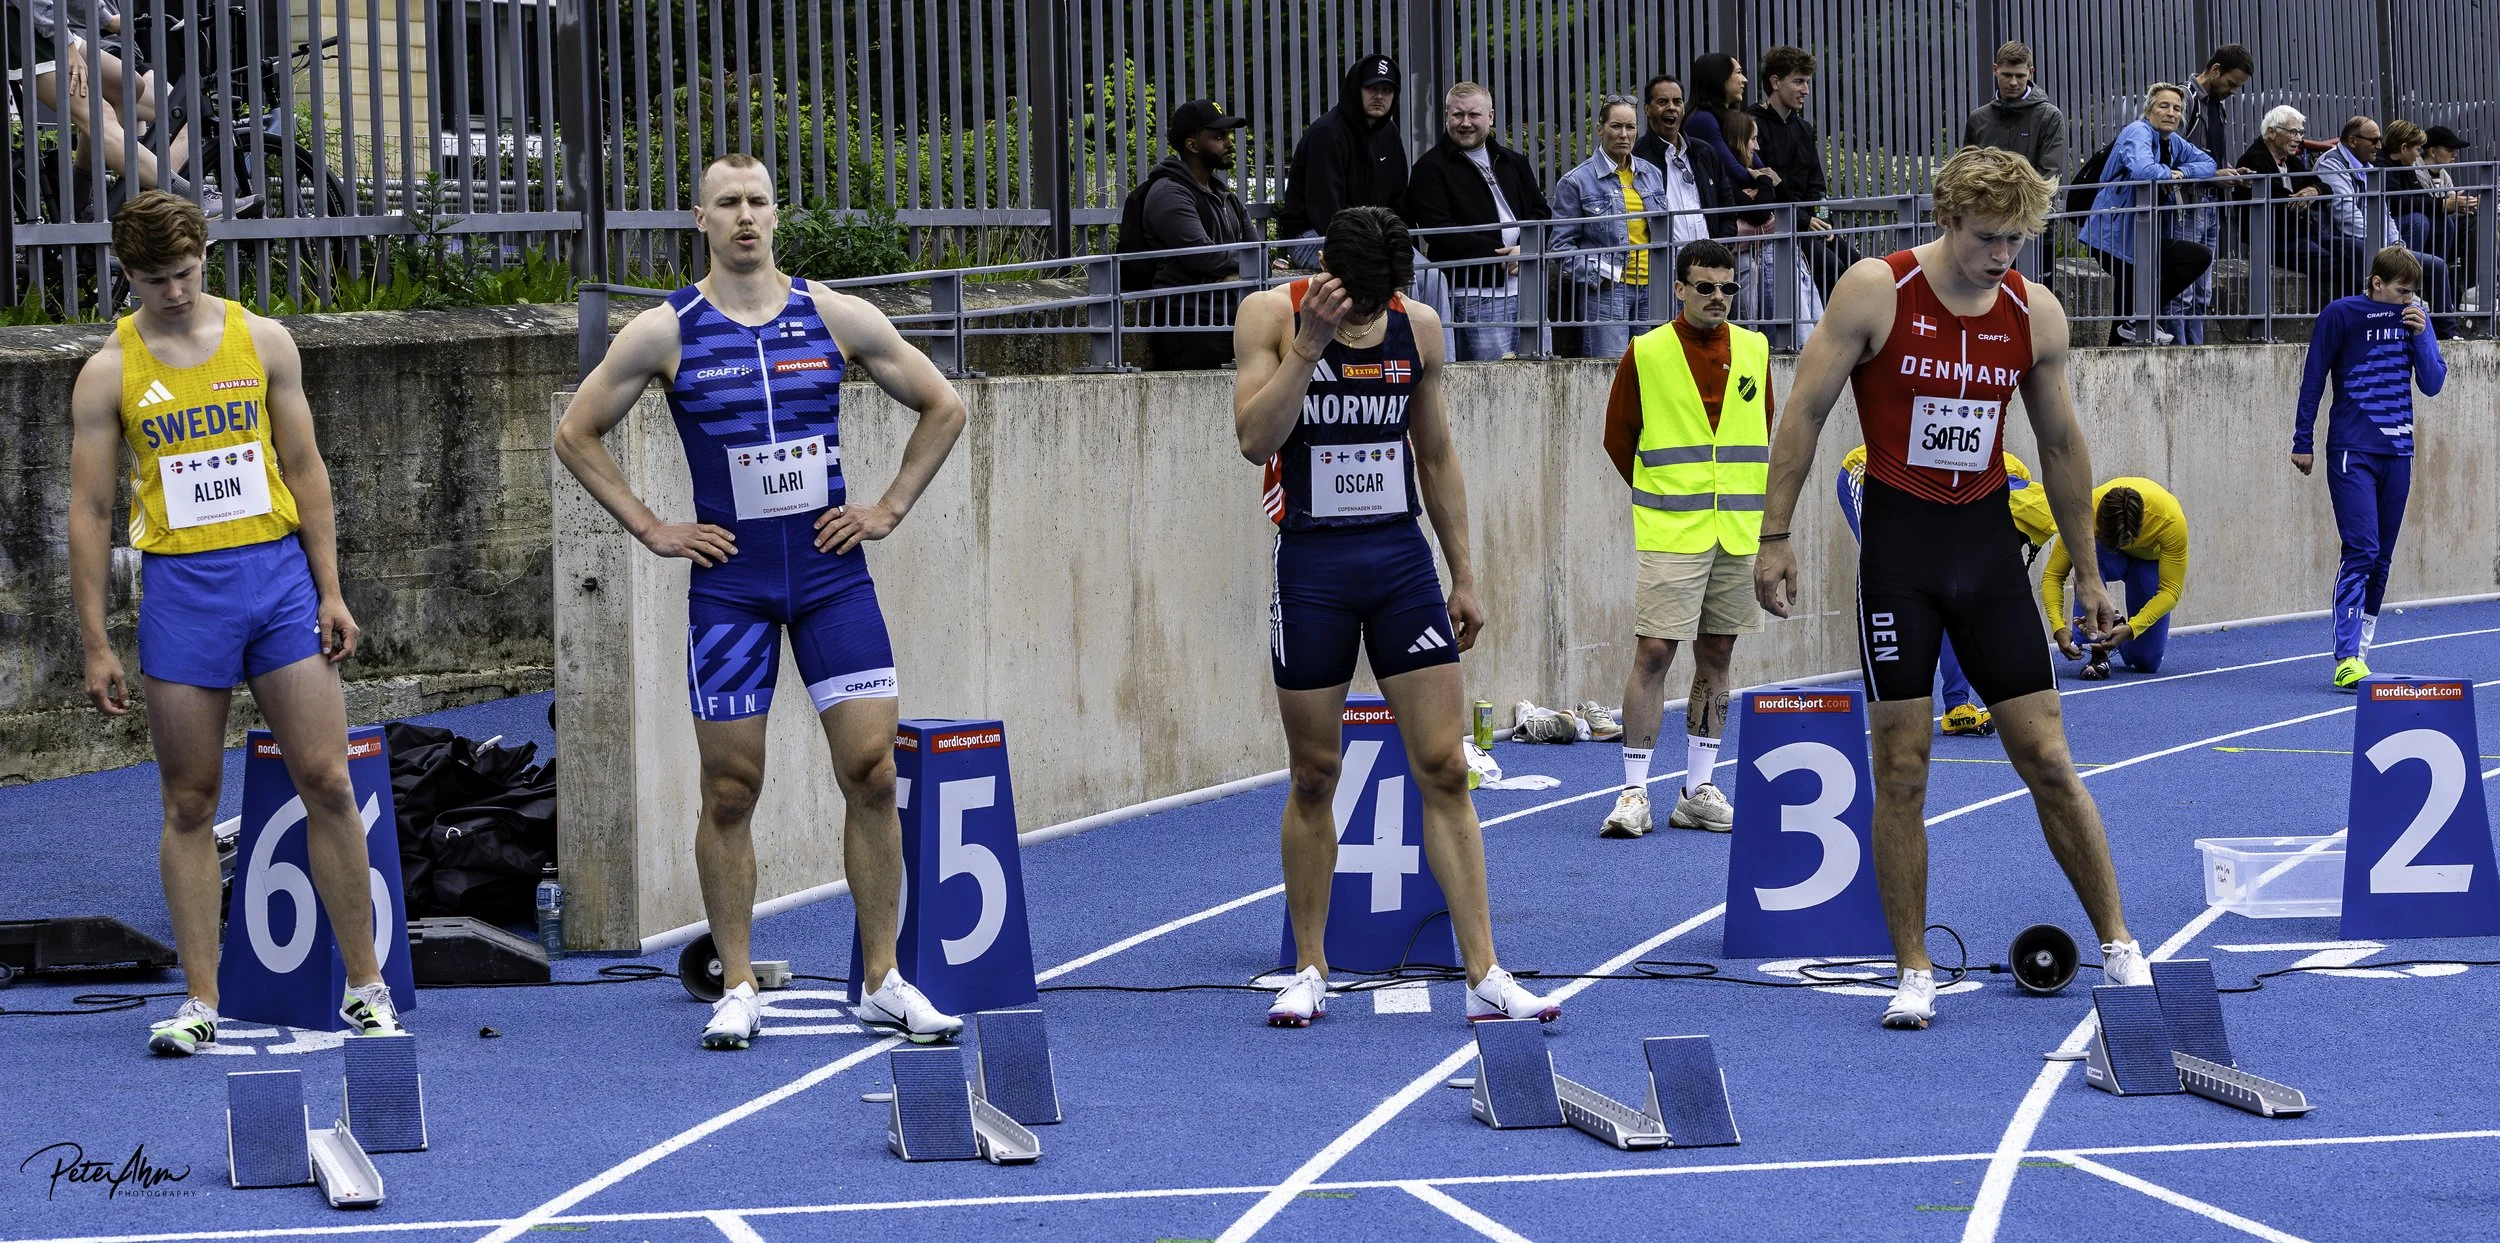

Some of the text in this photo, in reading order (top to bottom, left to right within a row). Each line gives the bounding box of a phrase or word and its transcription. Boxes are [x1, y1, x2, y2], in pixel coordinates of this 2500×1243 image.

[2366, 311, 2389, 319] CRAFT
[1978, 333, 2003, 342] CRAFT
[2366, 328, 2409, 341] FINL
[696, 367, 739, 379] CRAFT
[777, 360, 828, 371] motonet
[1900, 355, 2021, 387] DENMARK
[212, 379, 258, 390] BAUHAUS
[1303, 394, 1410, 425] NORWAY
[141, 400, 258, 449] SWEDEN
[1934, 459, 1968, 467] COPENHAGEN
[194, 476, 242, 503] ALBIN
[762, 470, 804, 495] ILARI
[1335, 473, 1384, 494] OSCAR
[196, 511, 232, 522] COPENHAGEN
[763, 505, 797, 514] COPENHAGEN
[1872, 612, 1899, 662] DEN
[845, 678, 888, 692] CRAFT
[2376, 685, 2462, 699] nordicsport.com
[707, 693, 756, 716] FIN
[1759, 697, 1849, 710] nordicsport.com
[1342, 710, 1396, 723] dicsport.
[1948, 716, 1977, 728] NITRO
[938, 731, 1001, 749] nordicsport.com
[2364, 728, 2474, 894] 2
[1331, 740, 1420, 914] 4
[1753, 741, 1861, 911] 3
[939, 775, 1007, 966] 5
[244, 794, 317, 974] 6
